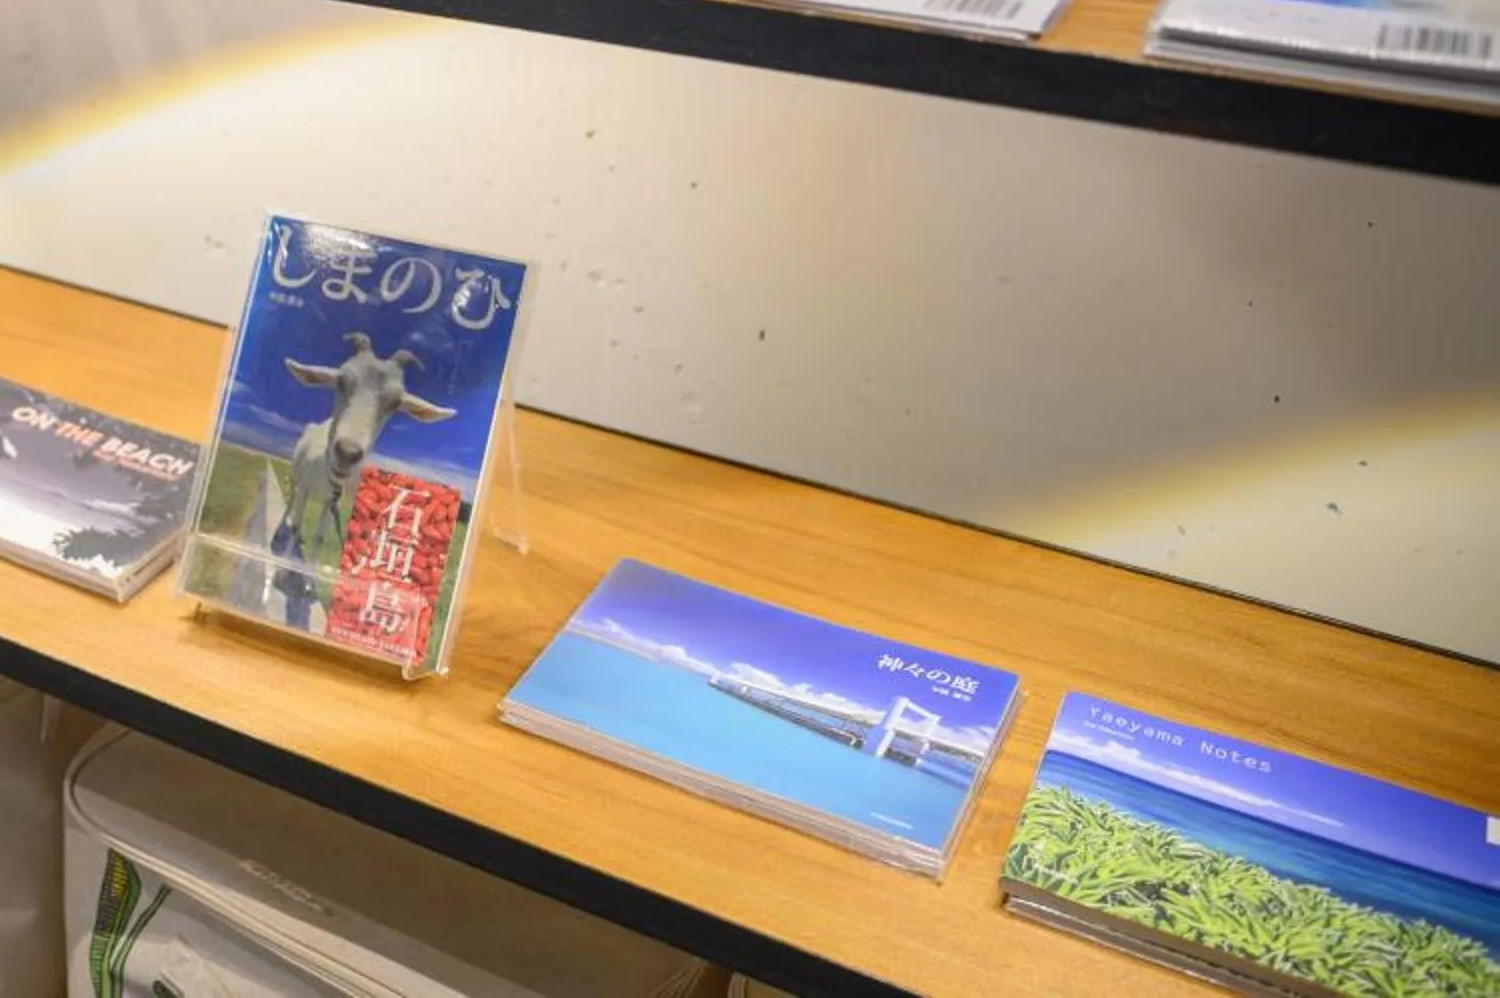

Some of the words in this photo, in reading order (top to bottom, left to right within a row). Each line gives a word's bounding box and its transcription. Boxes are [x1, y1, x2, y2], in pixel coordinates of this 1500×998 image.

[272, 224, 511, 331] しまのひ
[11, 406, 57, 431] ON
[55, 422, 105, 448] THE
[100, 436, 196, 476] BEACH
[359, 484, 431, 634] 石垣島
[876, 653, 981, 695] 神々の庭
[1090, 706, 1185, 747] Yaeyama
[1200, 740, 1273, 774] Notes
